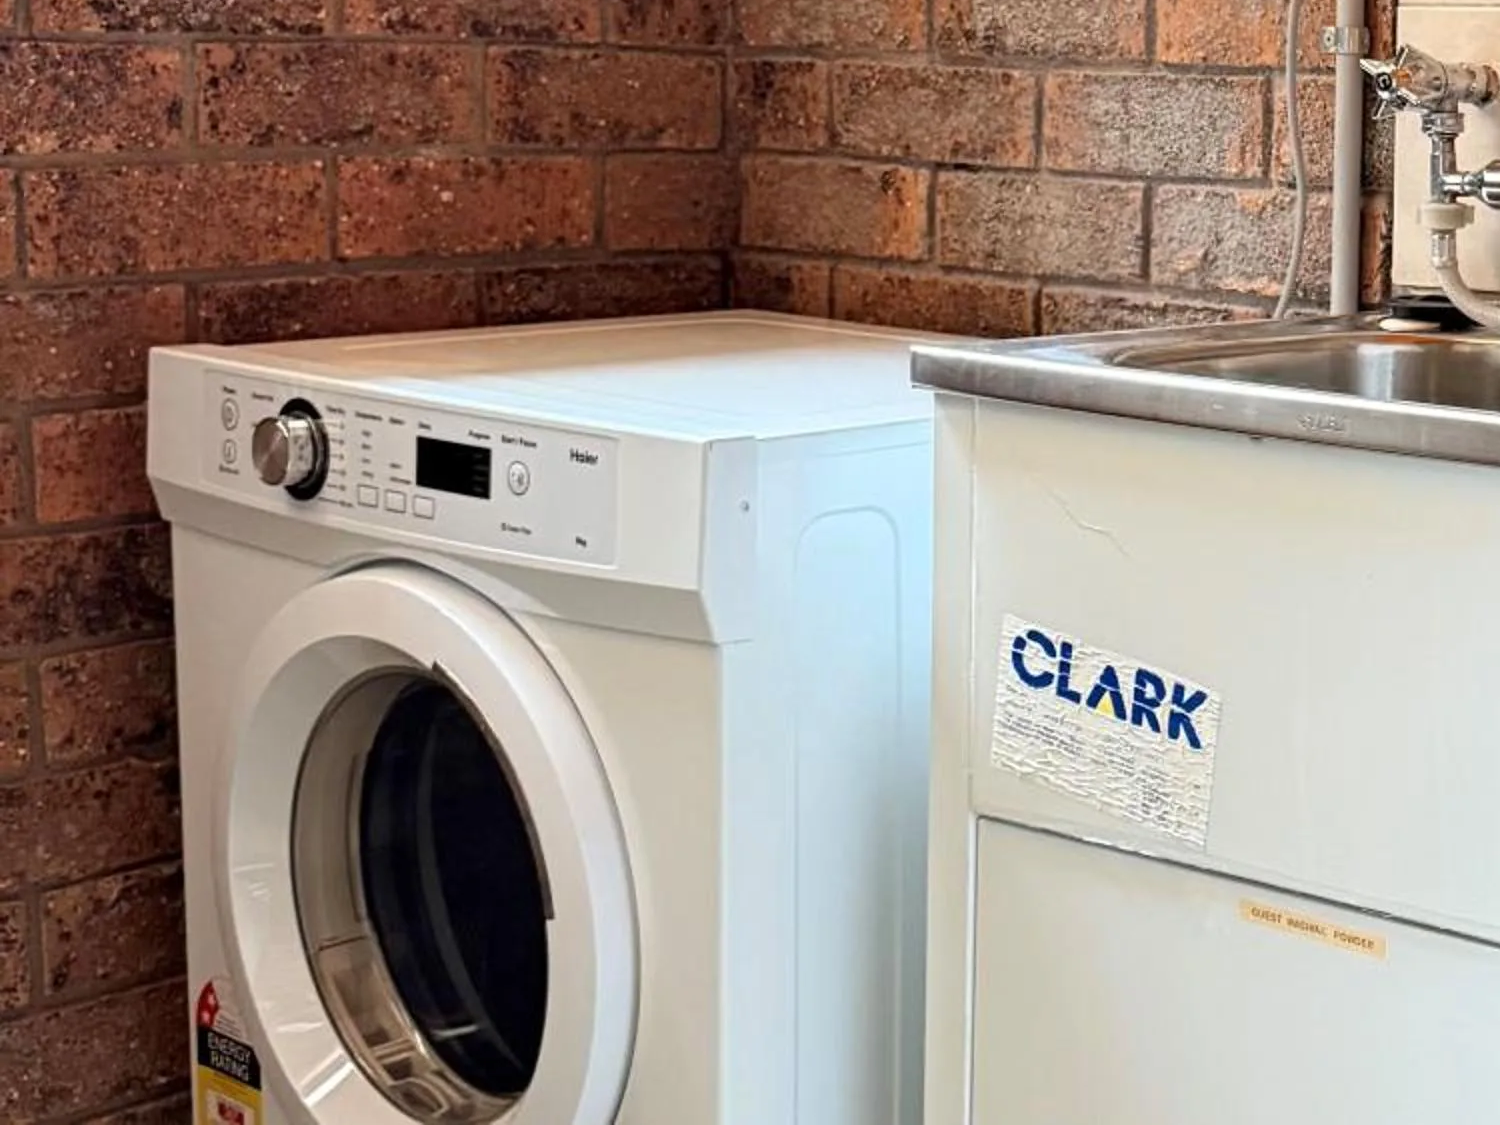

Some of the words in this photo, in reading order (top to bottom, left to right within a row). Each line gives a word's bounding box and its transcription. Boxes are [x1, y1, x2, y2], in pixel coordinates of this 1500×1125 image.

[569, 448, 599, 465] Haier
[1011, 629, 1208, 750] CLARK
[1251, 906, 1282, 923] GUEST
[1333, 930, 1375, 949] POWDER
[208, 1032, 250, 1063] ENERGY
[210, 1051, 249, 1081] RATING
